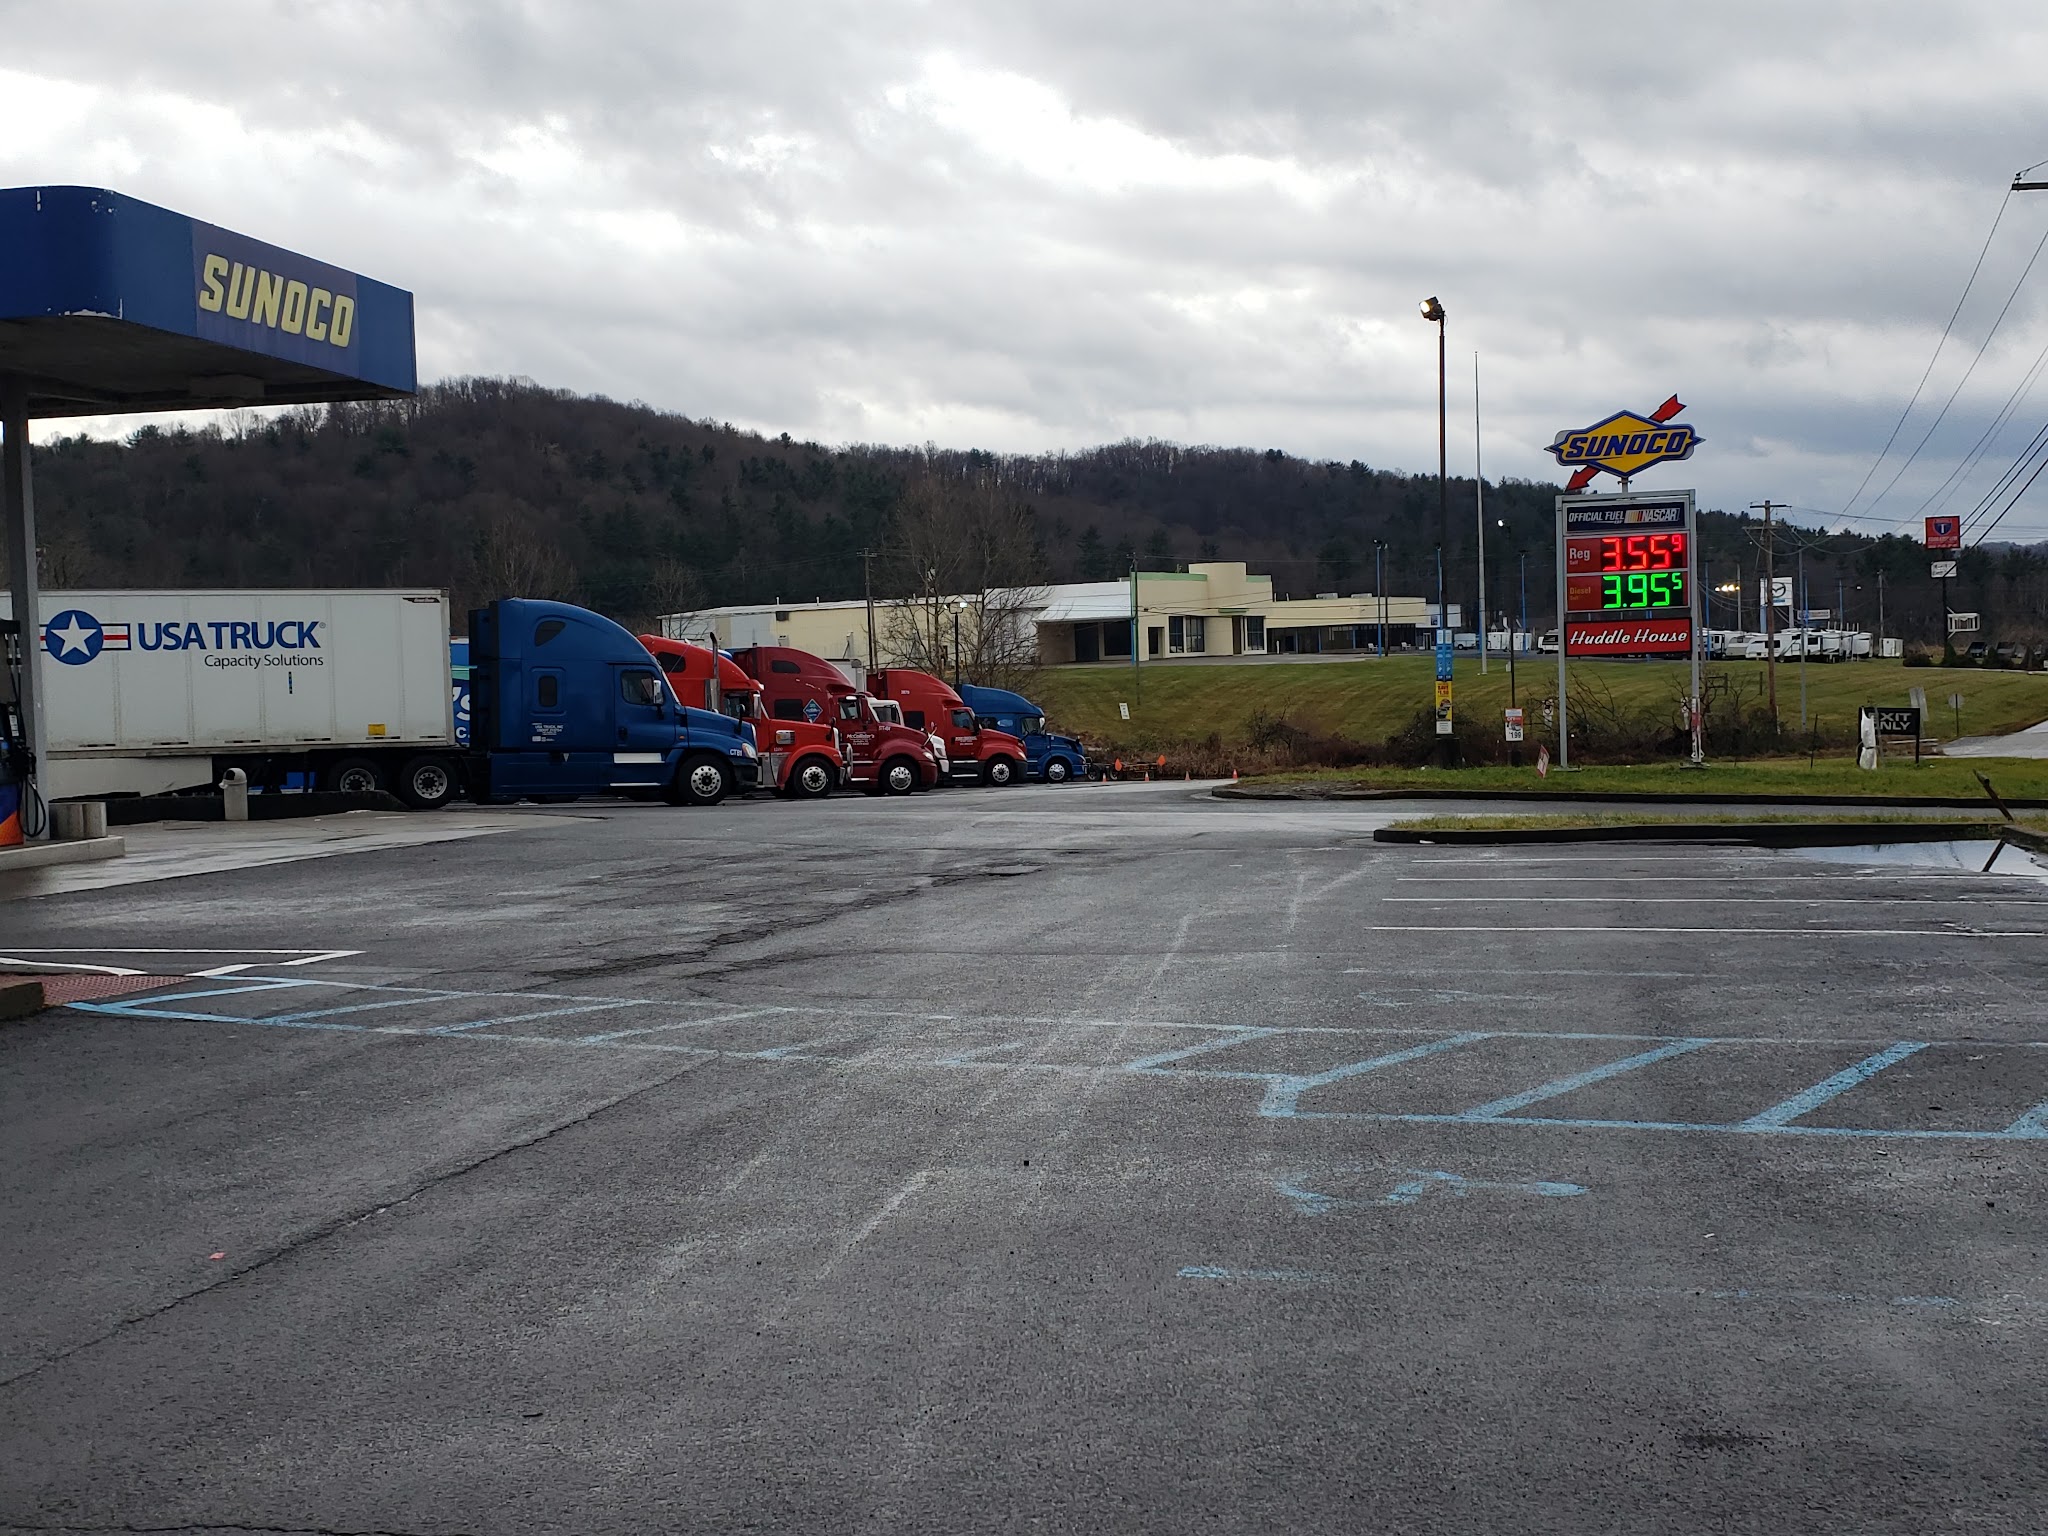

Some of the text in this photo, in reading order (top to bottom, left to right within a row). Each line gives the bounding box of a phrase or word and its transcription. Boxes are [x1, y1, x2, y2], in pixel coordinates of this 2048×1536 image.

[199, 253, 355, 348] SUNOCO
[1566, 431, 1688, 458] SUNOCO
[1568, 510, 1625, 522] OFFICIAL FUEL
[1642, 509, 1678, 521] NASCAR
[1569, 548, 1591, 561] Reg
[138, 621, 321, 651] USA TRUCK
[1569, 628, 1688, 645] Huddle House
[204, 654, 324, 669] Capacity Solutions
